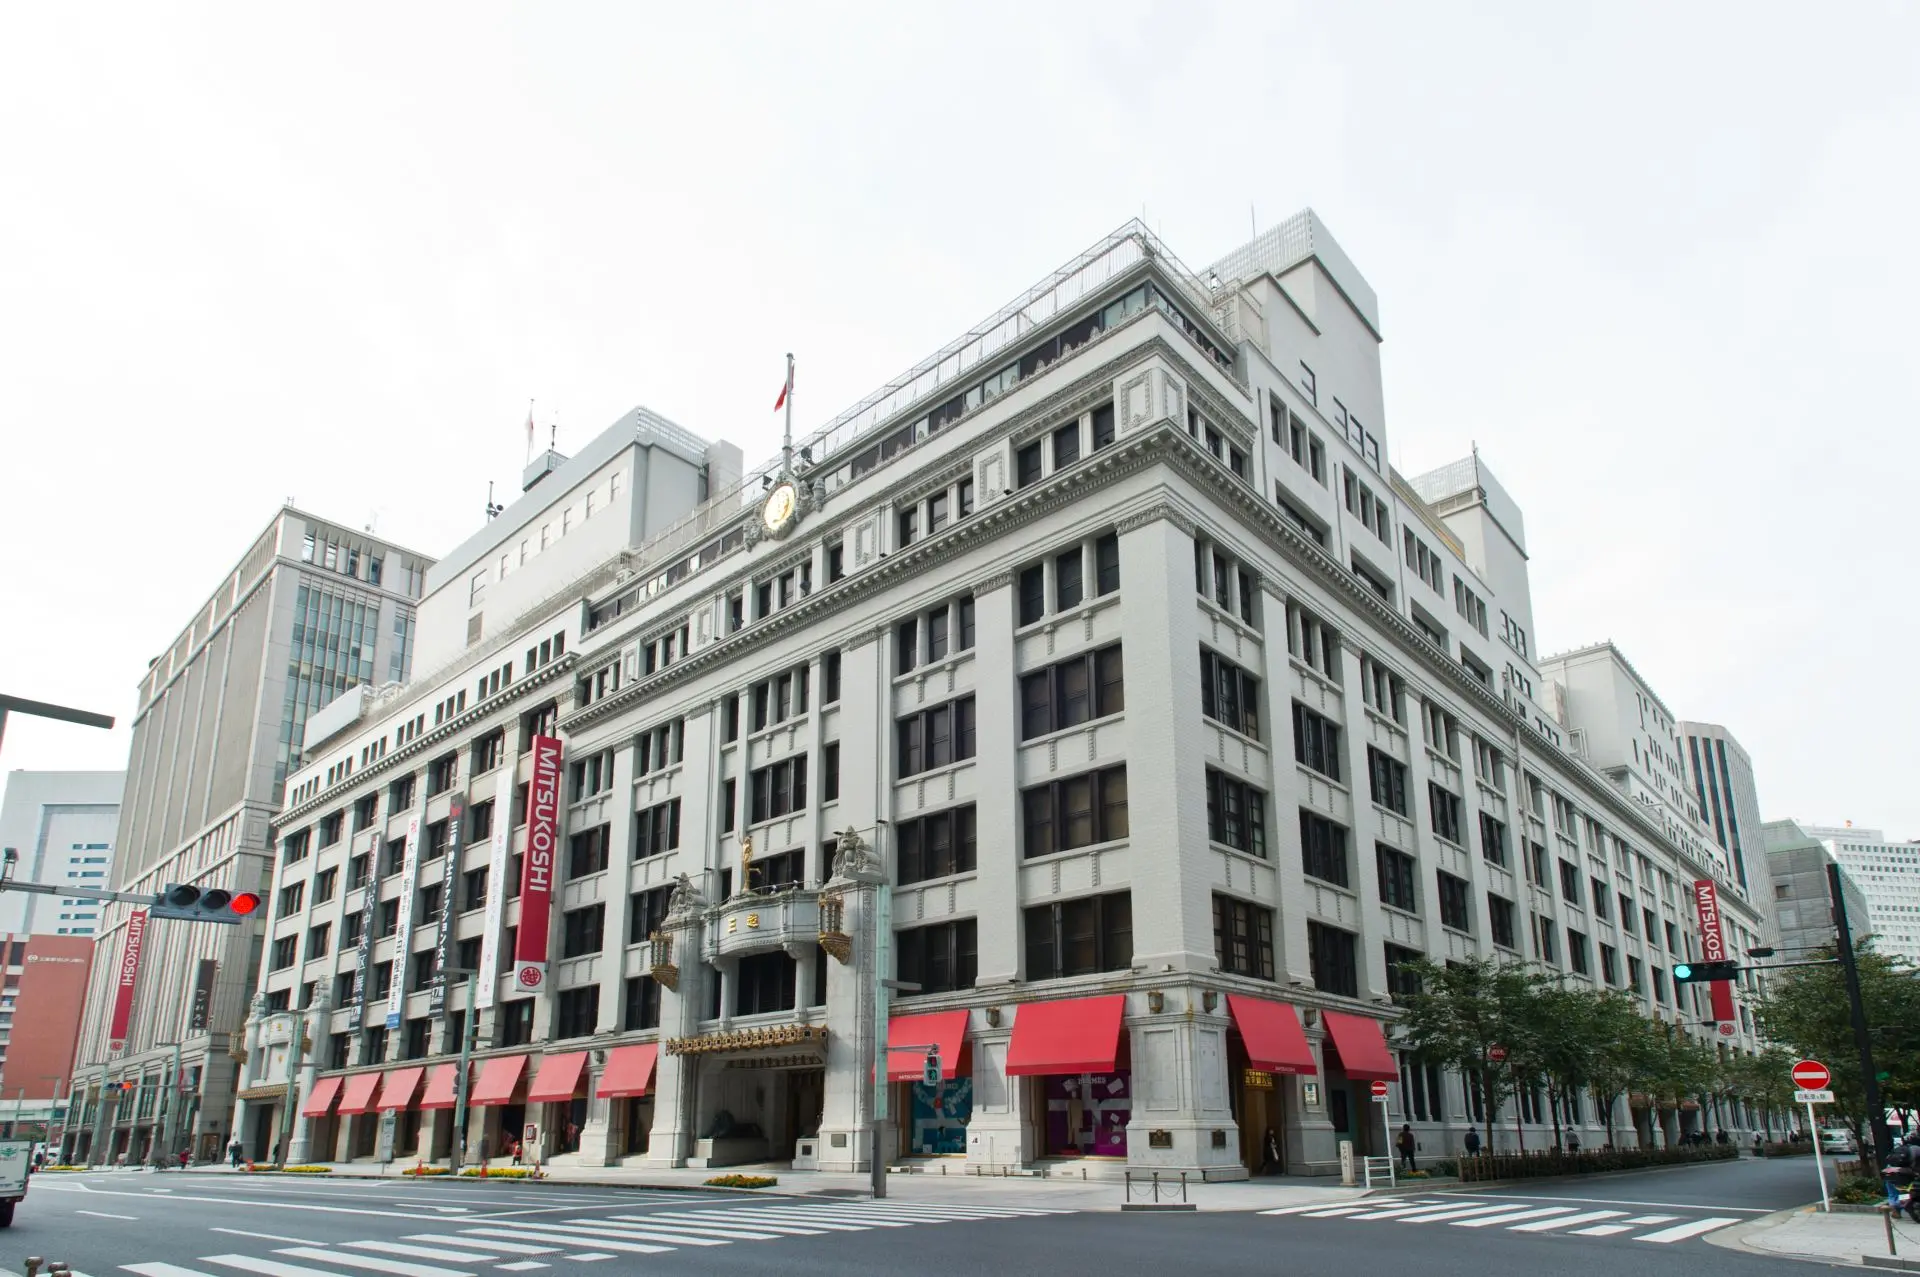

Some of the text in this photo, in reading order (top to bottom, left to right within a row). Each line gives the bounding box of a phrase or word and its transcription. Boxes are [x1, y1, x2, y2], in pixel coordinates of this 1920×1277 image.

[529, 746, 558, 892] MITSUKOSHI
[121, 915, 144, 986] MITSUKOSHI
[1698, 886, 1722, 961] MITSUKOS
